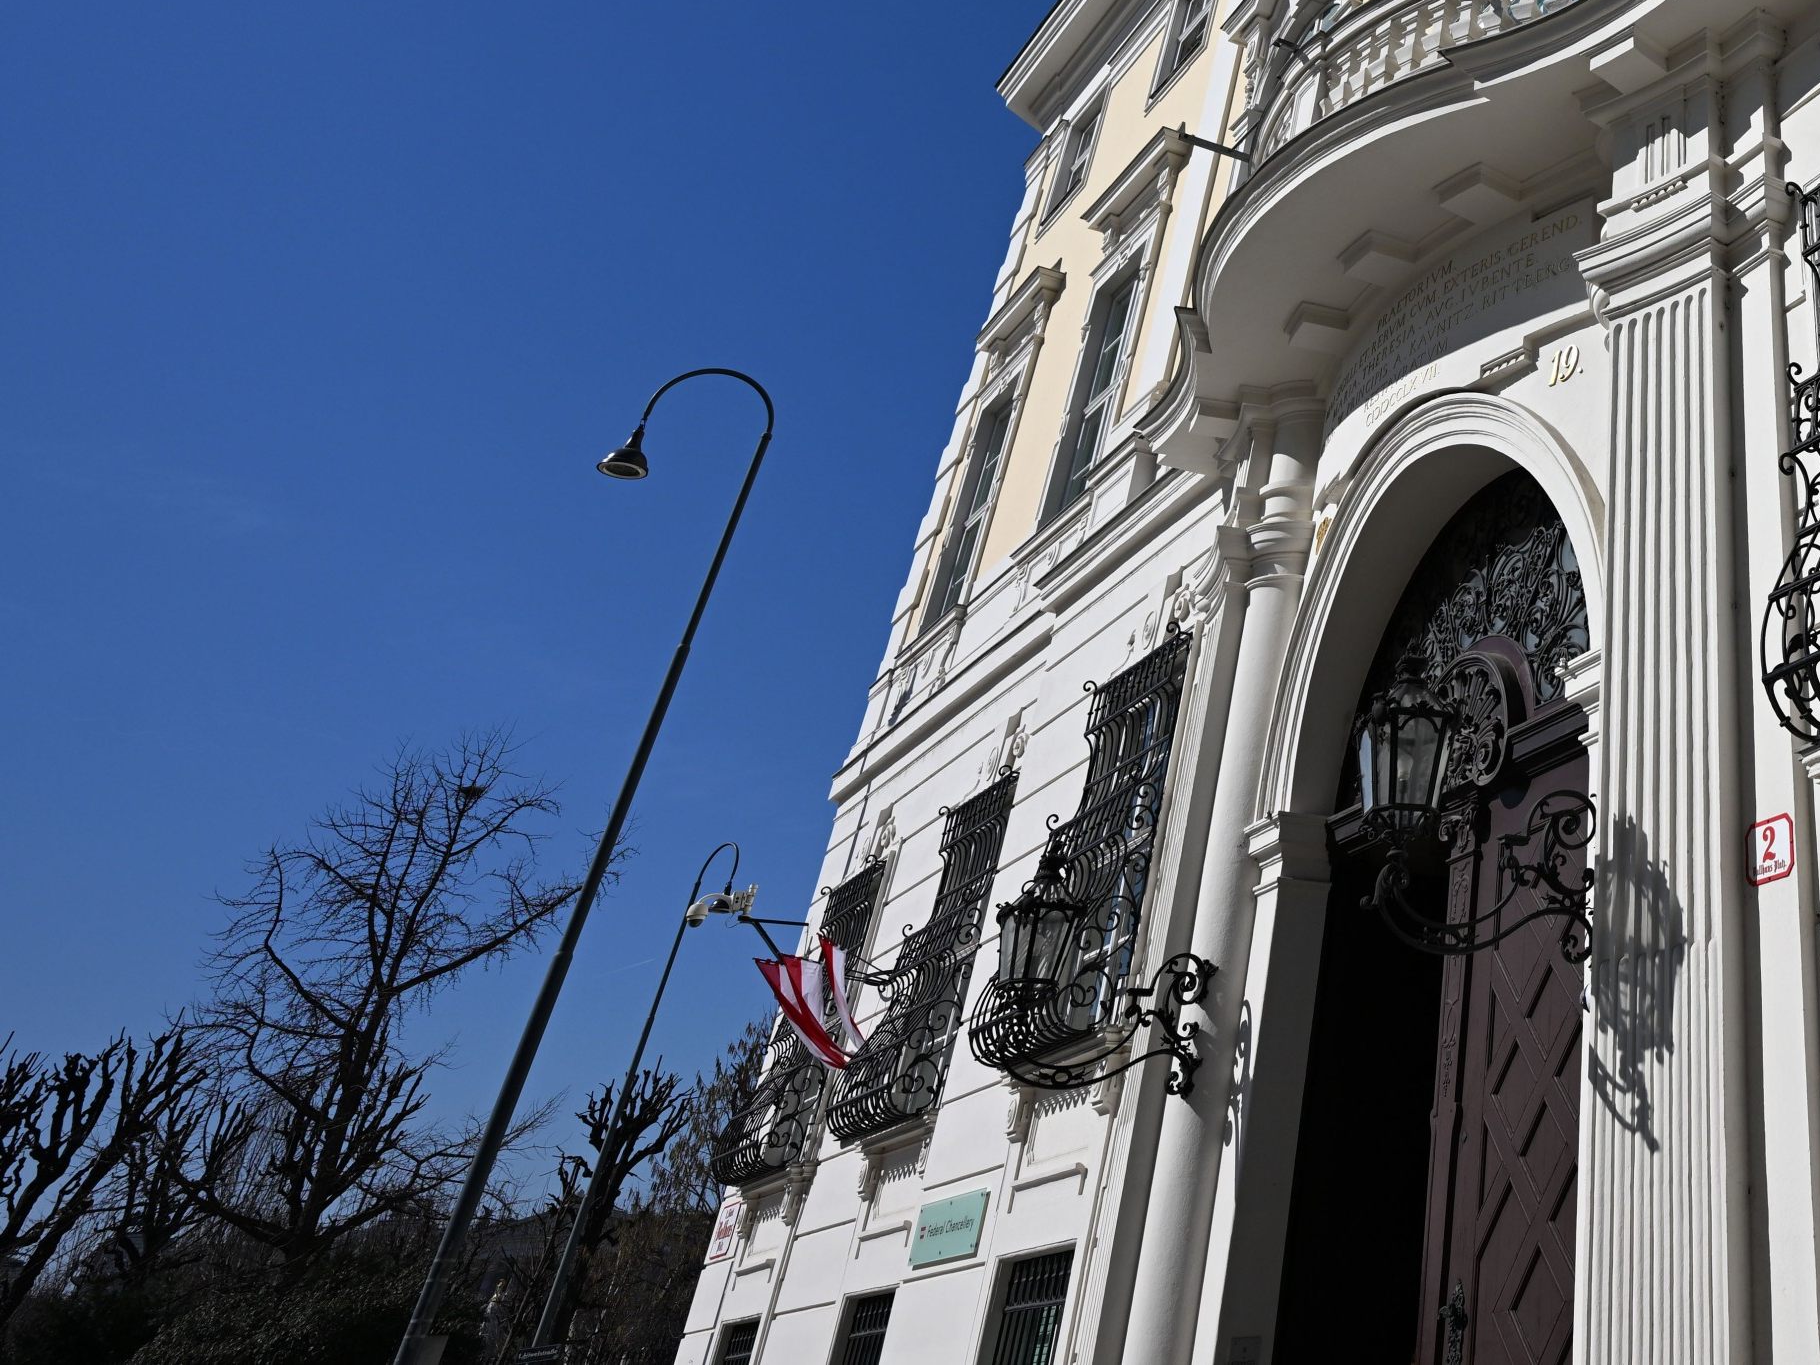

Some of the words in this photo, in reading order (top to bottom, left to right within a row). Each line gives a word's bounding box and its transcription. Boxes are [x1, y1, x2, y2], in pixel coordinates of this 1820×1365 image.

[1762, 825, 1777, 864] 2
[926, 1220, 946, 1238] Federal
[945, 1215, 975, 1233] Chancellery
